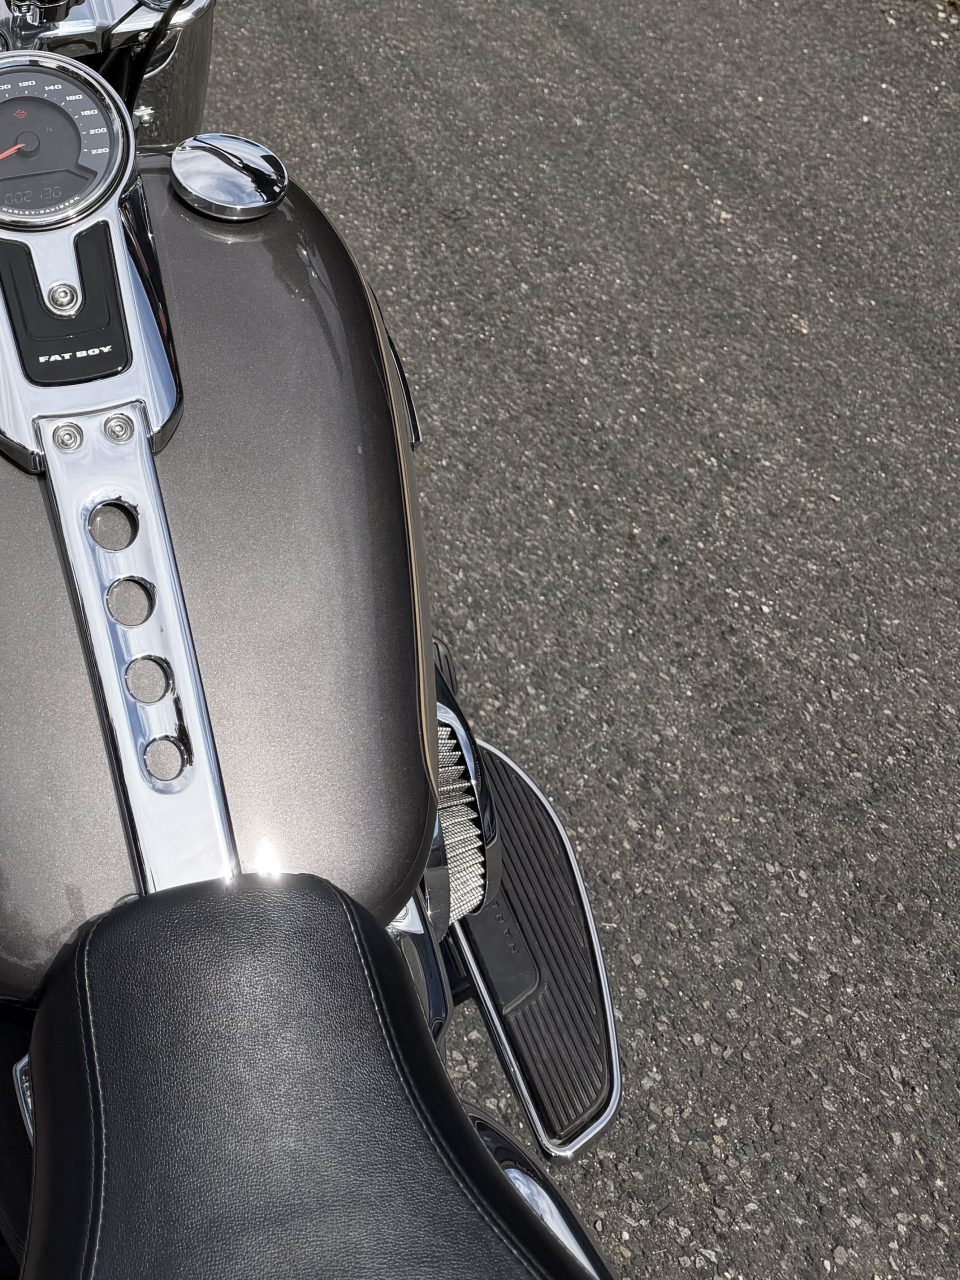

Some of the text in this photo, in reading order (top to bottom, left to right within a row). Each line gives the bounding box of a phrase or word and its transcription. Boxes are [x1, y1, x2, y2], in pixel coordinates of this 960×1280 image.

[89, 127, 107, 135] 200
[90, 147, 109, 155] 220
[2, 196, 80, 215] HARLEY-DAVIDSON
[38, 345, 113, 363] FAT BOY
